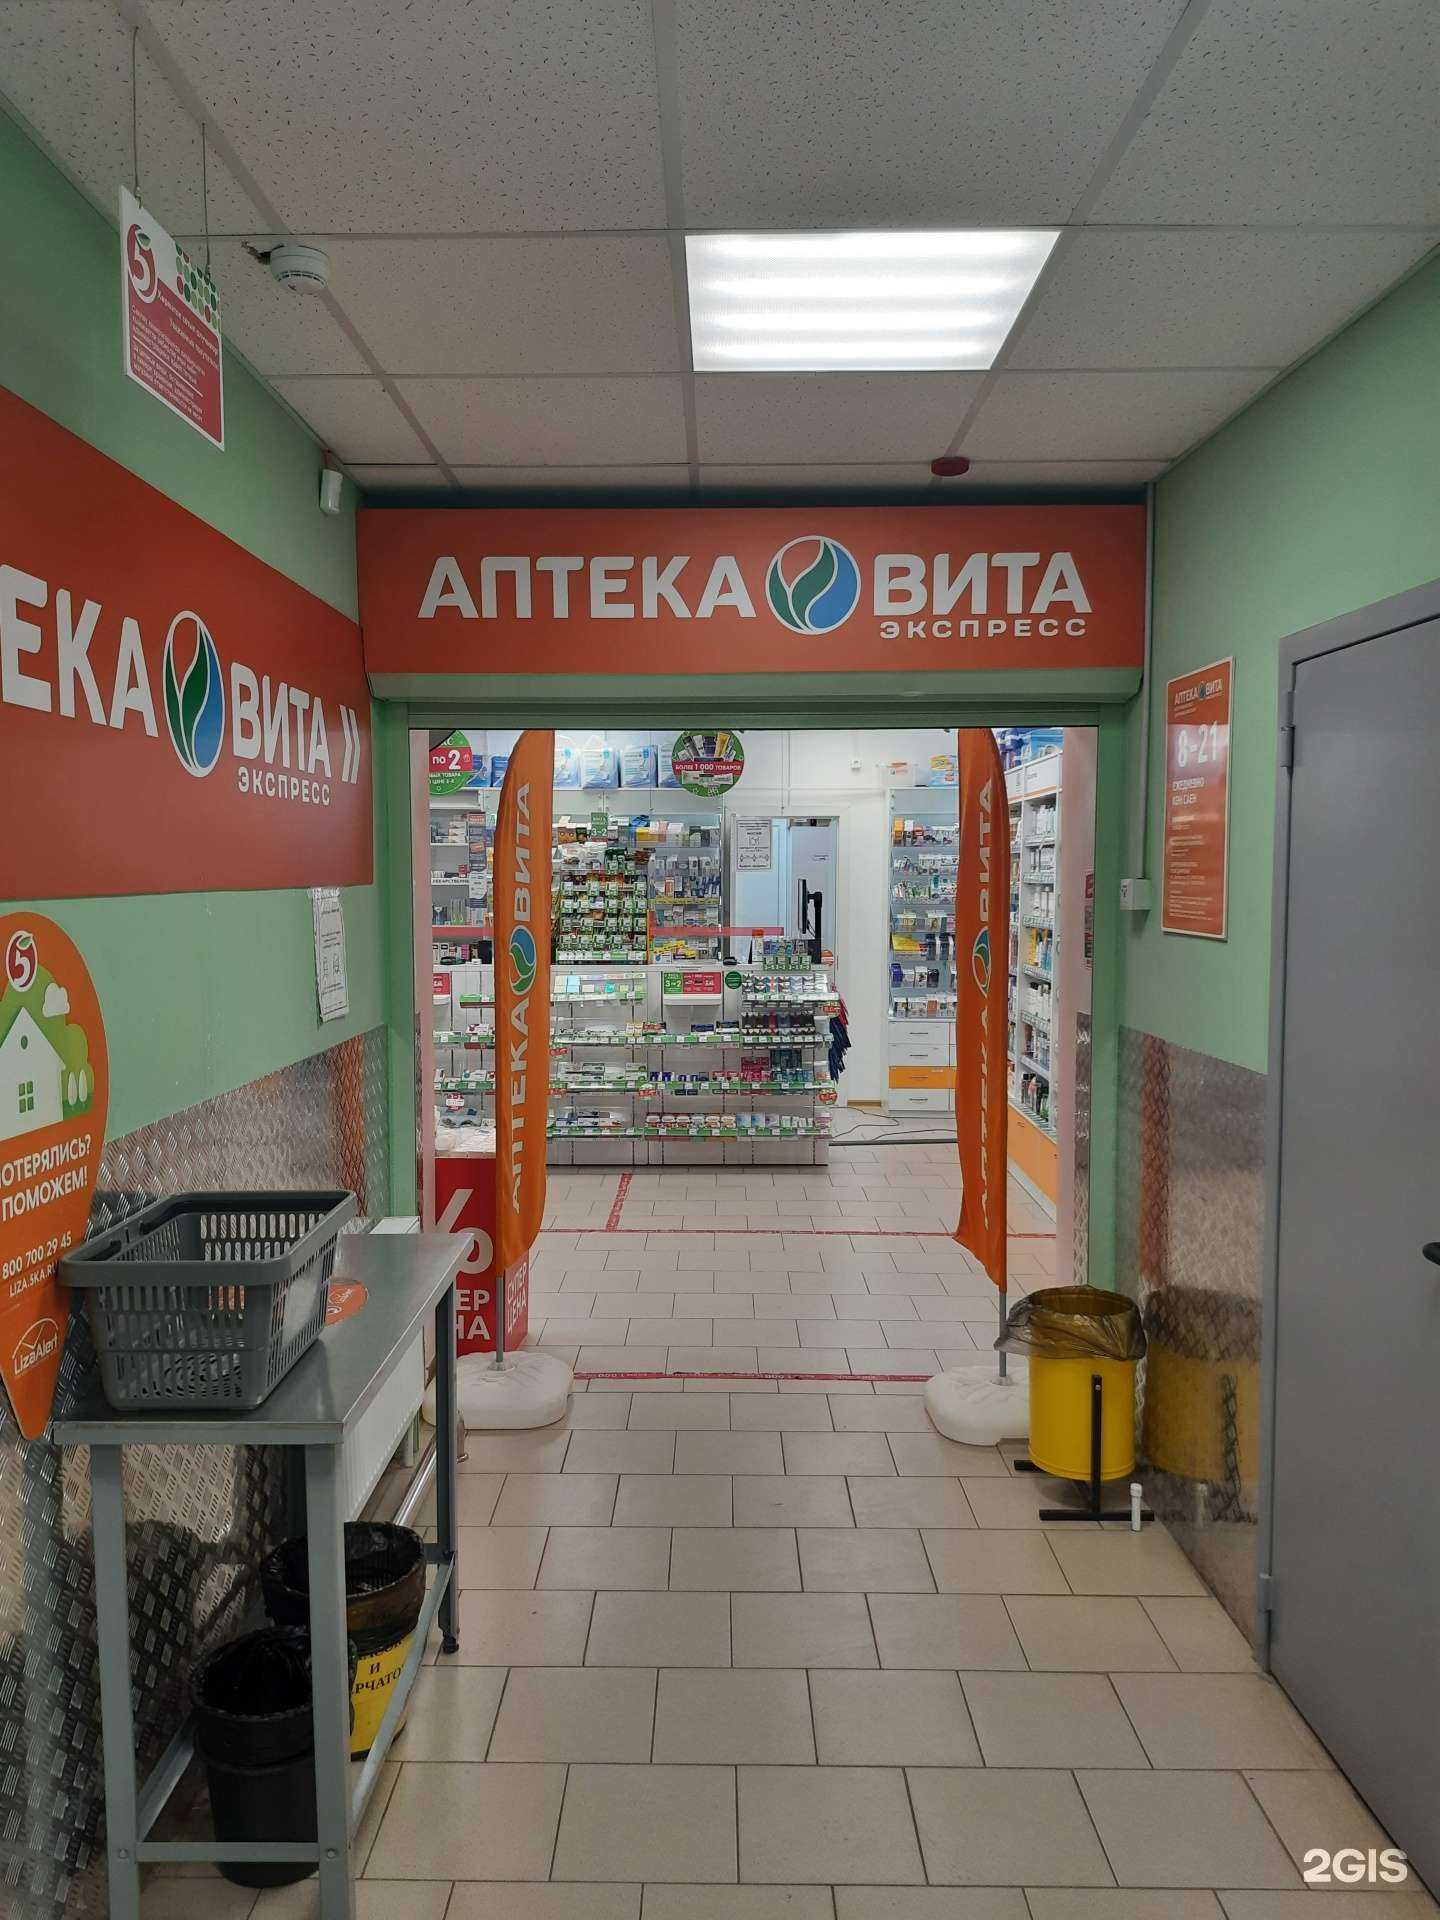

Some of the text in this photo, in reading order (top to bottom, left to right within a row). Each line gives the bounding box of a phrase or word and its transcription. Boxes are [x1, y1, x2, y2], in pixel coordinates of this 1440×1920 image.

[417, 551, 1093, 618] АПТЕКА ВИТА
[879, 619, 1088, 639] ЭКСПРЕСС
[230, 662, 332, 778] ВИТА
[237, 766, 331, 806] ЭКСПРЕСС
[448, 749, 462, 770] 2
[513, 783, 531, 922] ВИТА
[509, 997, 531, 1215] АПТЕКА
[0, 1134, 91, 1188] ОТЕРЯЛИСЬ?
[2, 1165, 88, 1222] ПОМОЖЕМ!
[2, 1230, 72, 1281] 800 700 29 45
[14, 1331, 58, 1376] LizaAlert
